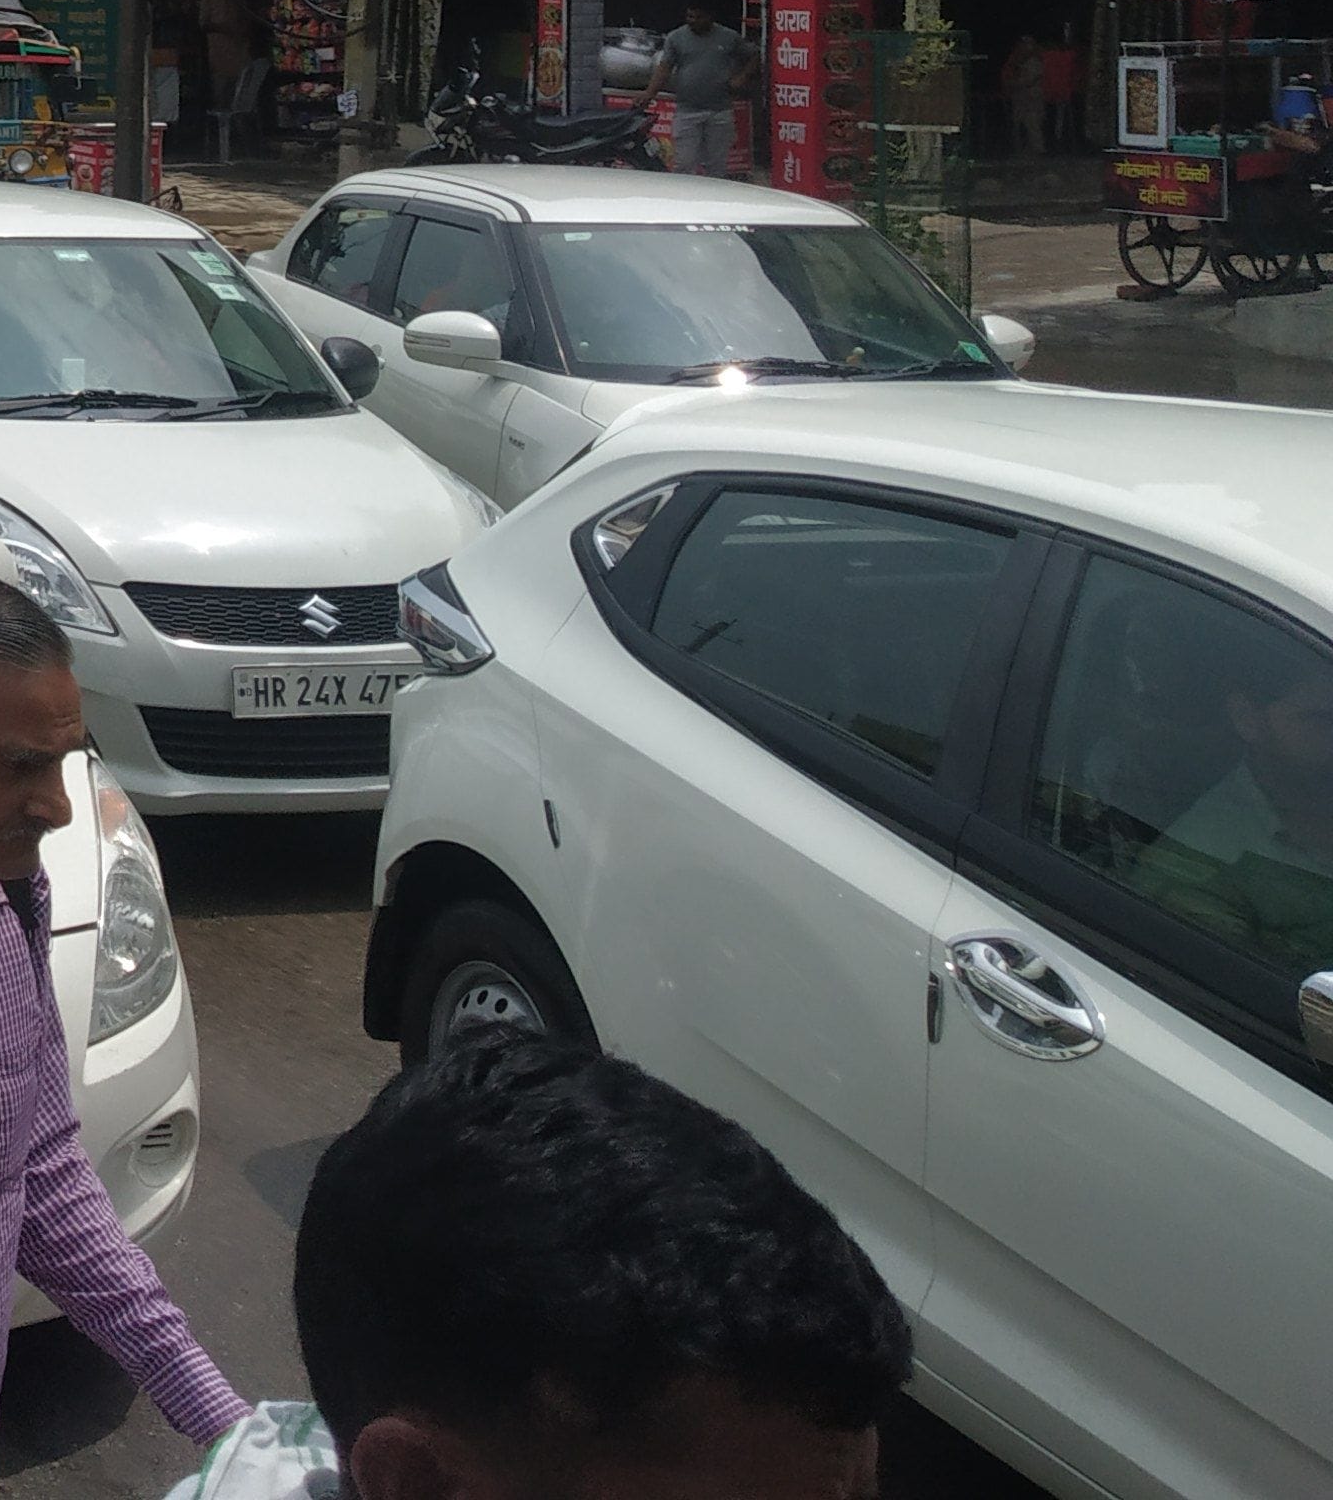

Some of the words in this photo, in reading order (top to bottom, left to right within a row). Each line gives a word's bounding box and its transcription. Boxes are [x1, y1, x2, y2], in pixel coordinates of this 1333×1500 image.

[775, 10, 812, 33] शराब
[777, 47, 809, 71] पीना
[778, 121, 806, 145] मना
[254, 676, 287, 708] HR
[297, 675, 347, 706] 24X
